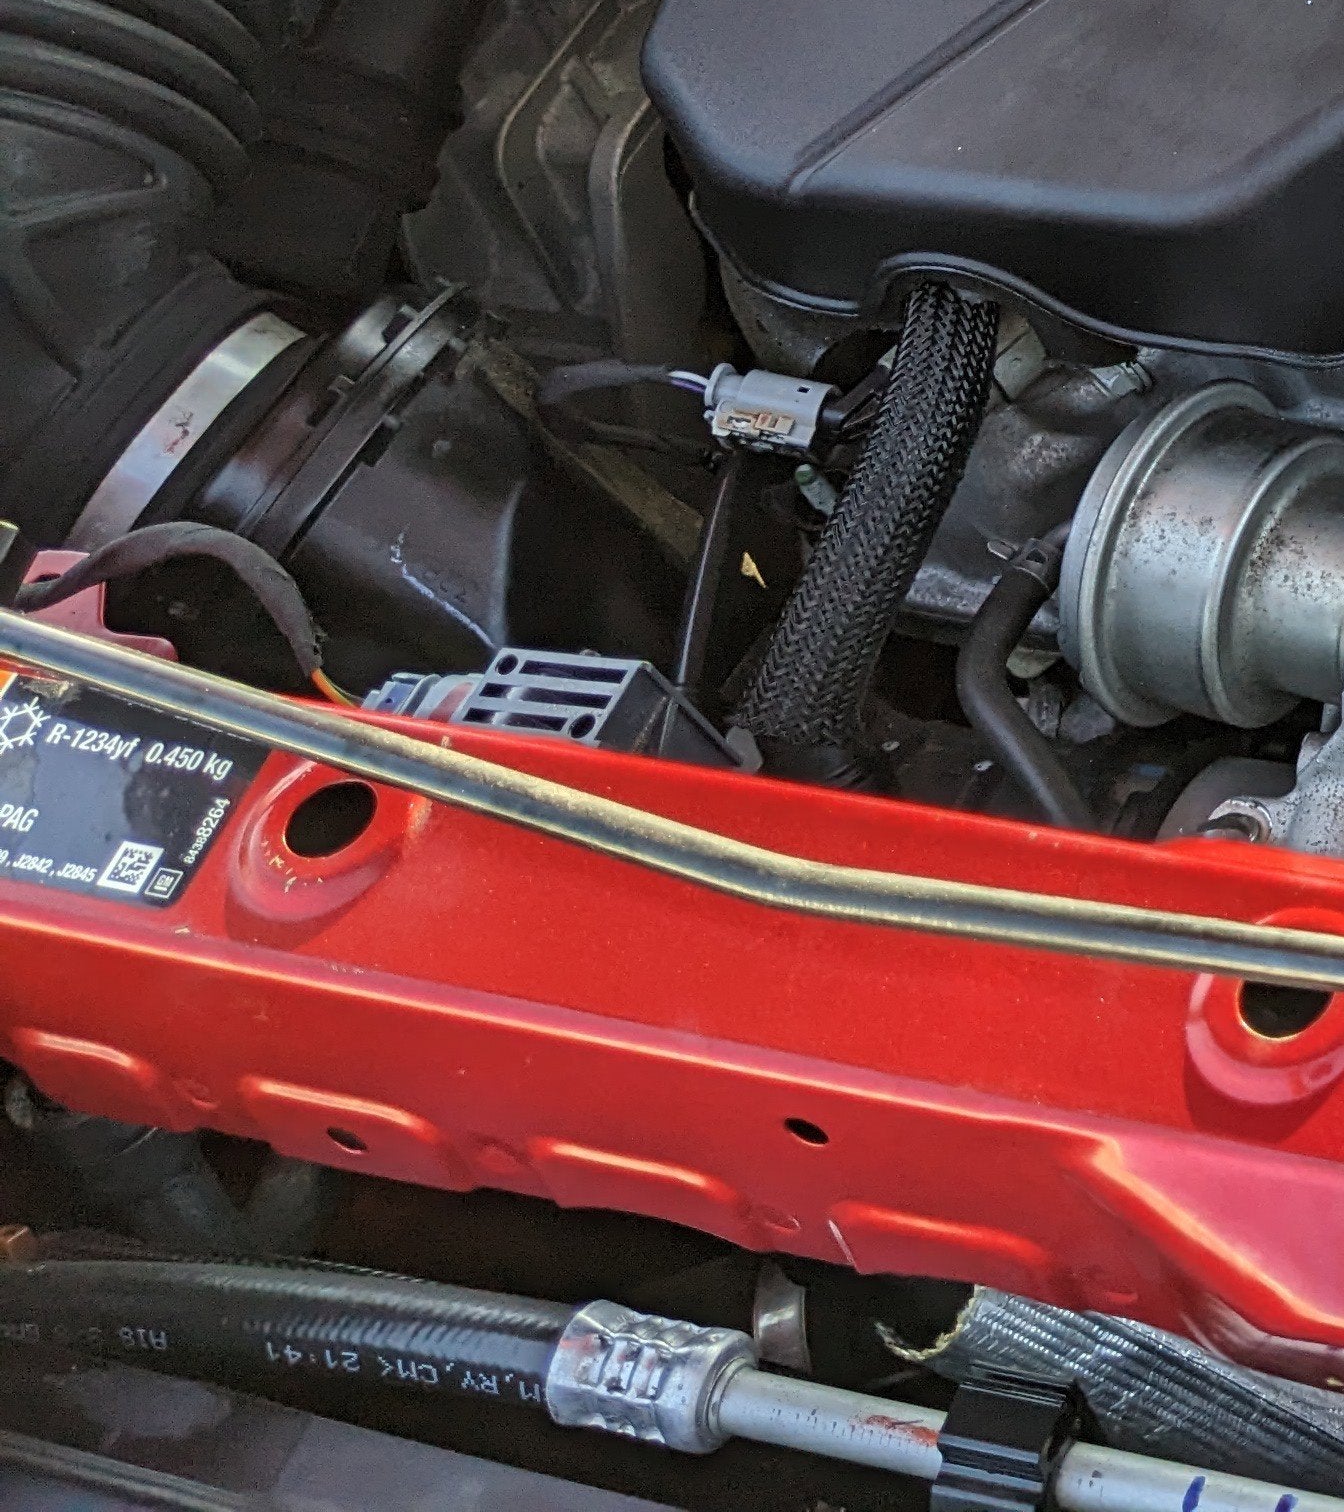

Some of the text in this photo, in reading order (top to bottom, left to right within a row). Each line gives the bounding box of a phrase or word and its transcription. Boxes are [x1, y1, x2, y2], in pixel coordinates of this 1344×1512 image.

[46, 723, 234, 781] R-1234yf 0.450 kg
